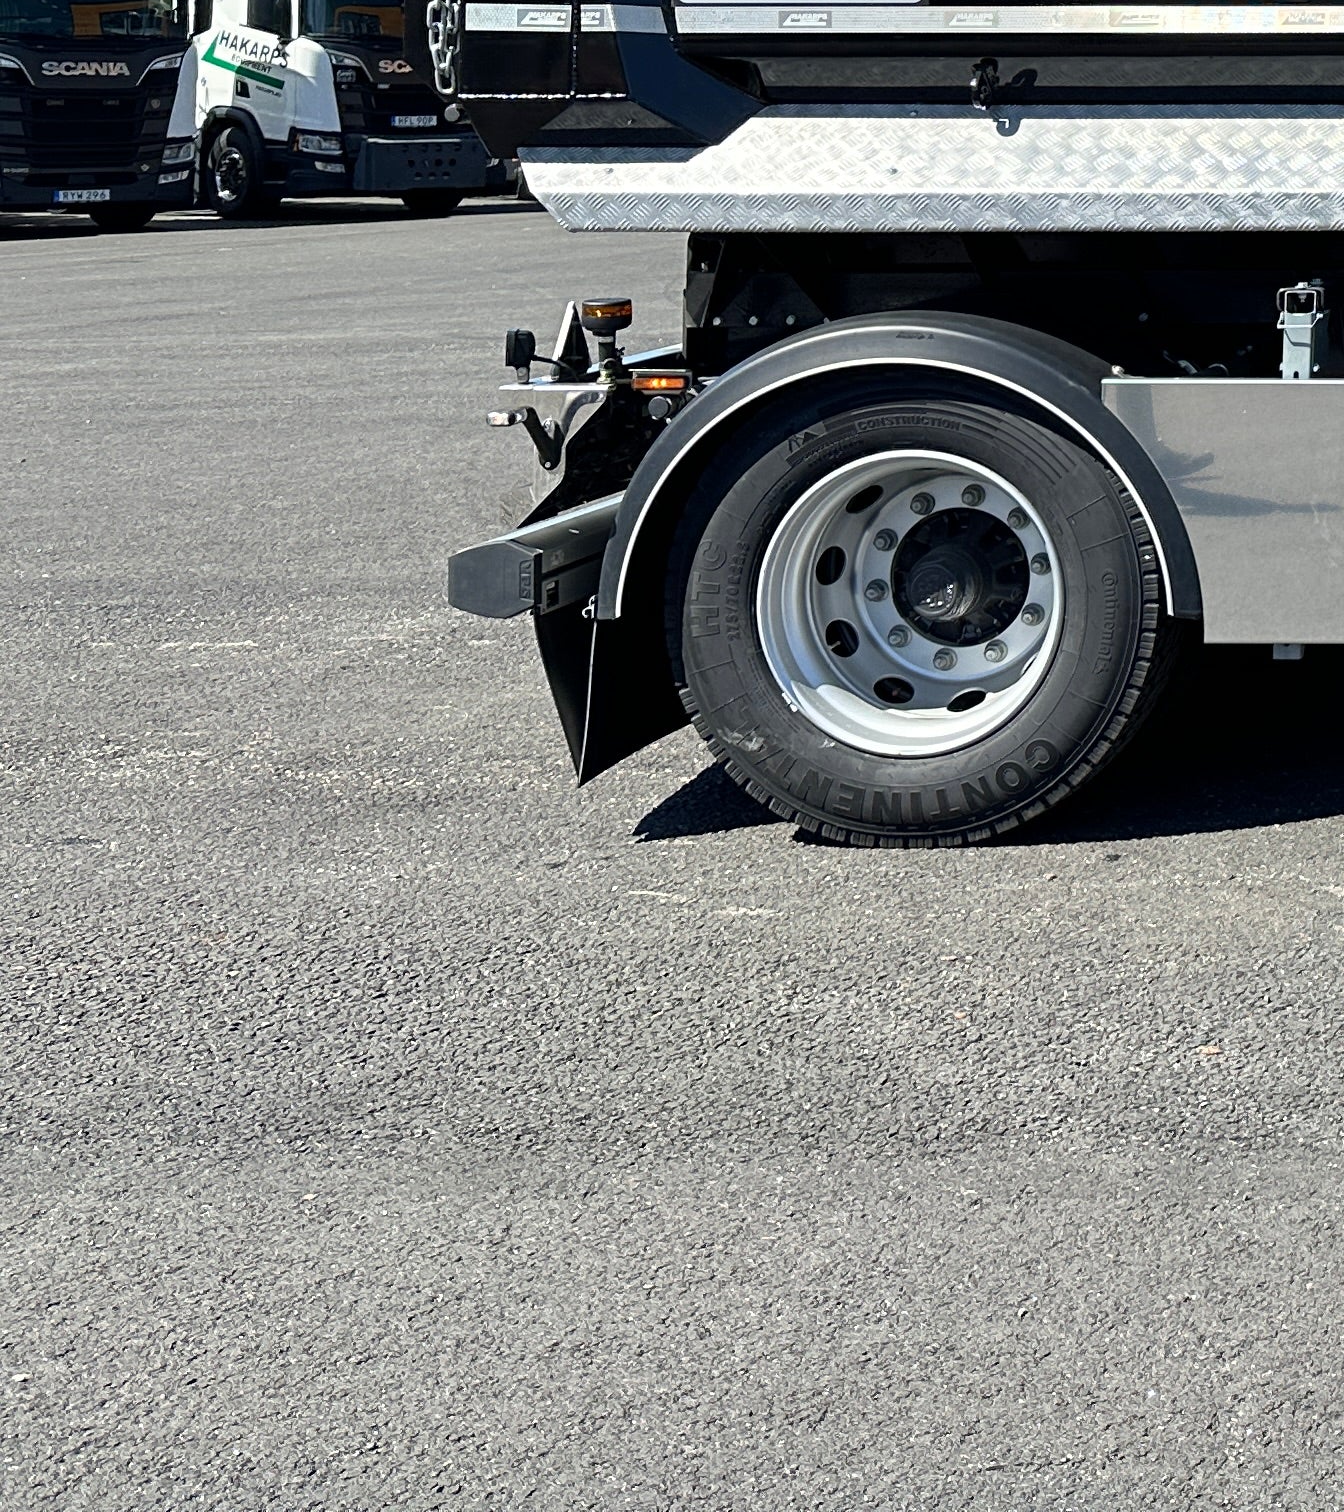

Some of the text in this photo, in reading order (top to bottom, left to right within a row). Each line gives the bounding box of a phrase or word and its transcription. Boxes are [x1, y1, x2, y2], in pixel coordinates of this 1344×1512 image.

[219, 29, 290, 68] HAKARPS
[41, 61, 131, 76] SCANIA
[86, 190, 106, 199] 296
[857, 414, 961, 432] CONSTRUCTION
[689, 539, 727, 638] HTC
